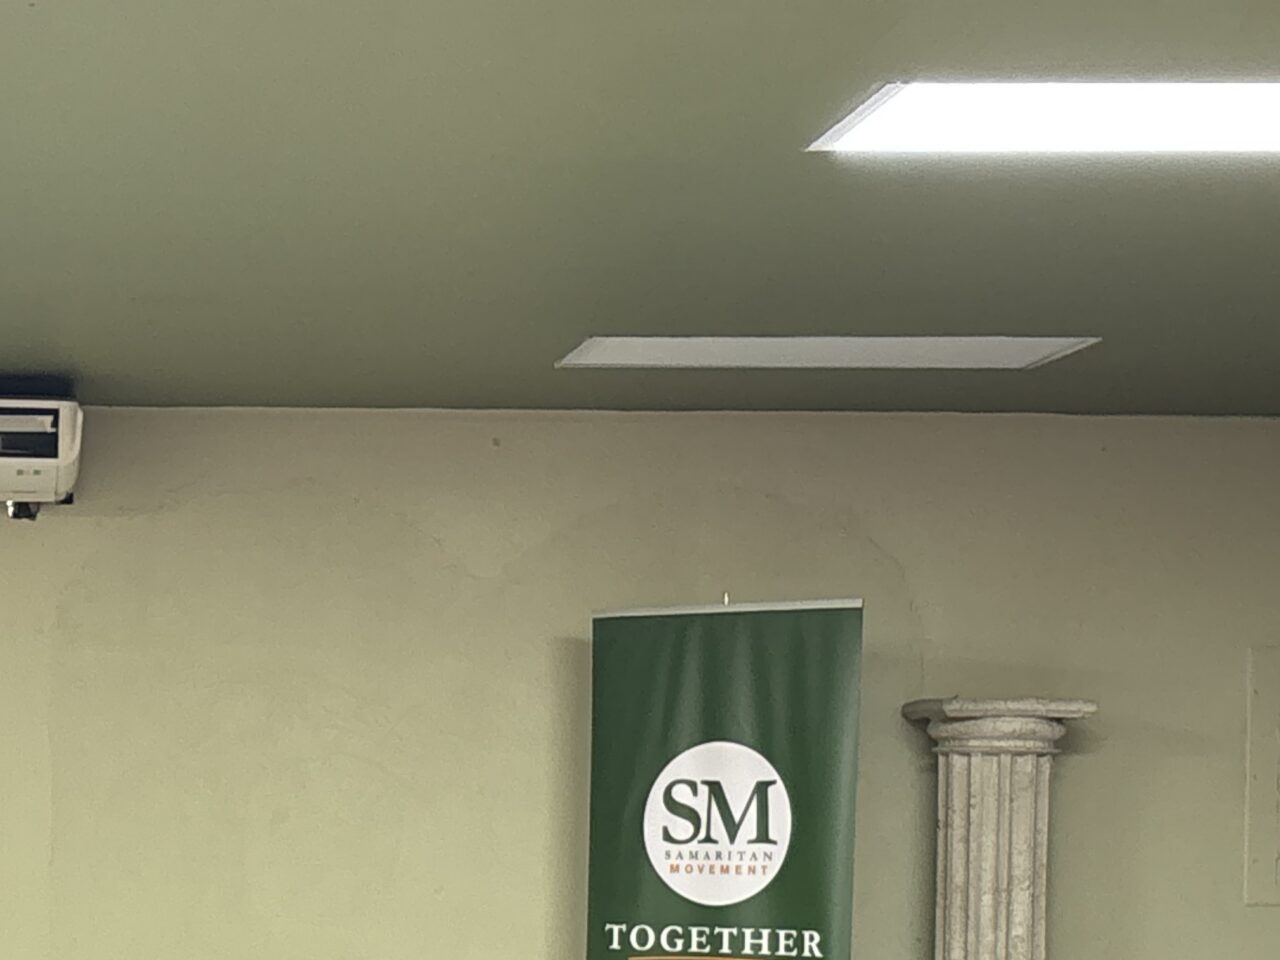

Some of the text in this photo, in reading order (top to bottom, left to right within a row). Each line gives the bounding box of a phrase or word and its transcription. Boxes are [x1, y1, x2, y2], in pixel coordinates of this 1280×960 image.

[662, 778, 778, 845] SM
[665, 850, 773, 862] SAMARITAN
[669, 863, 768, 876] MOVEMENT
[605, 923, 824, 958] TOGETHER
